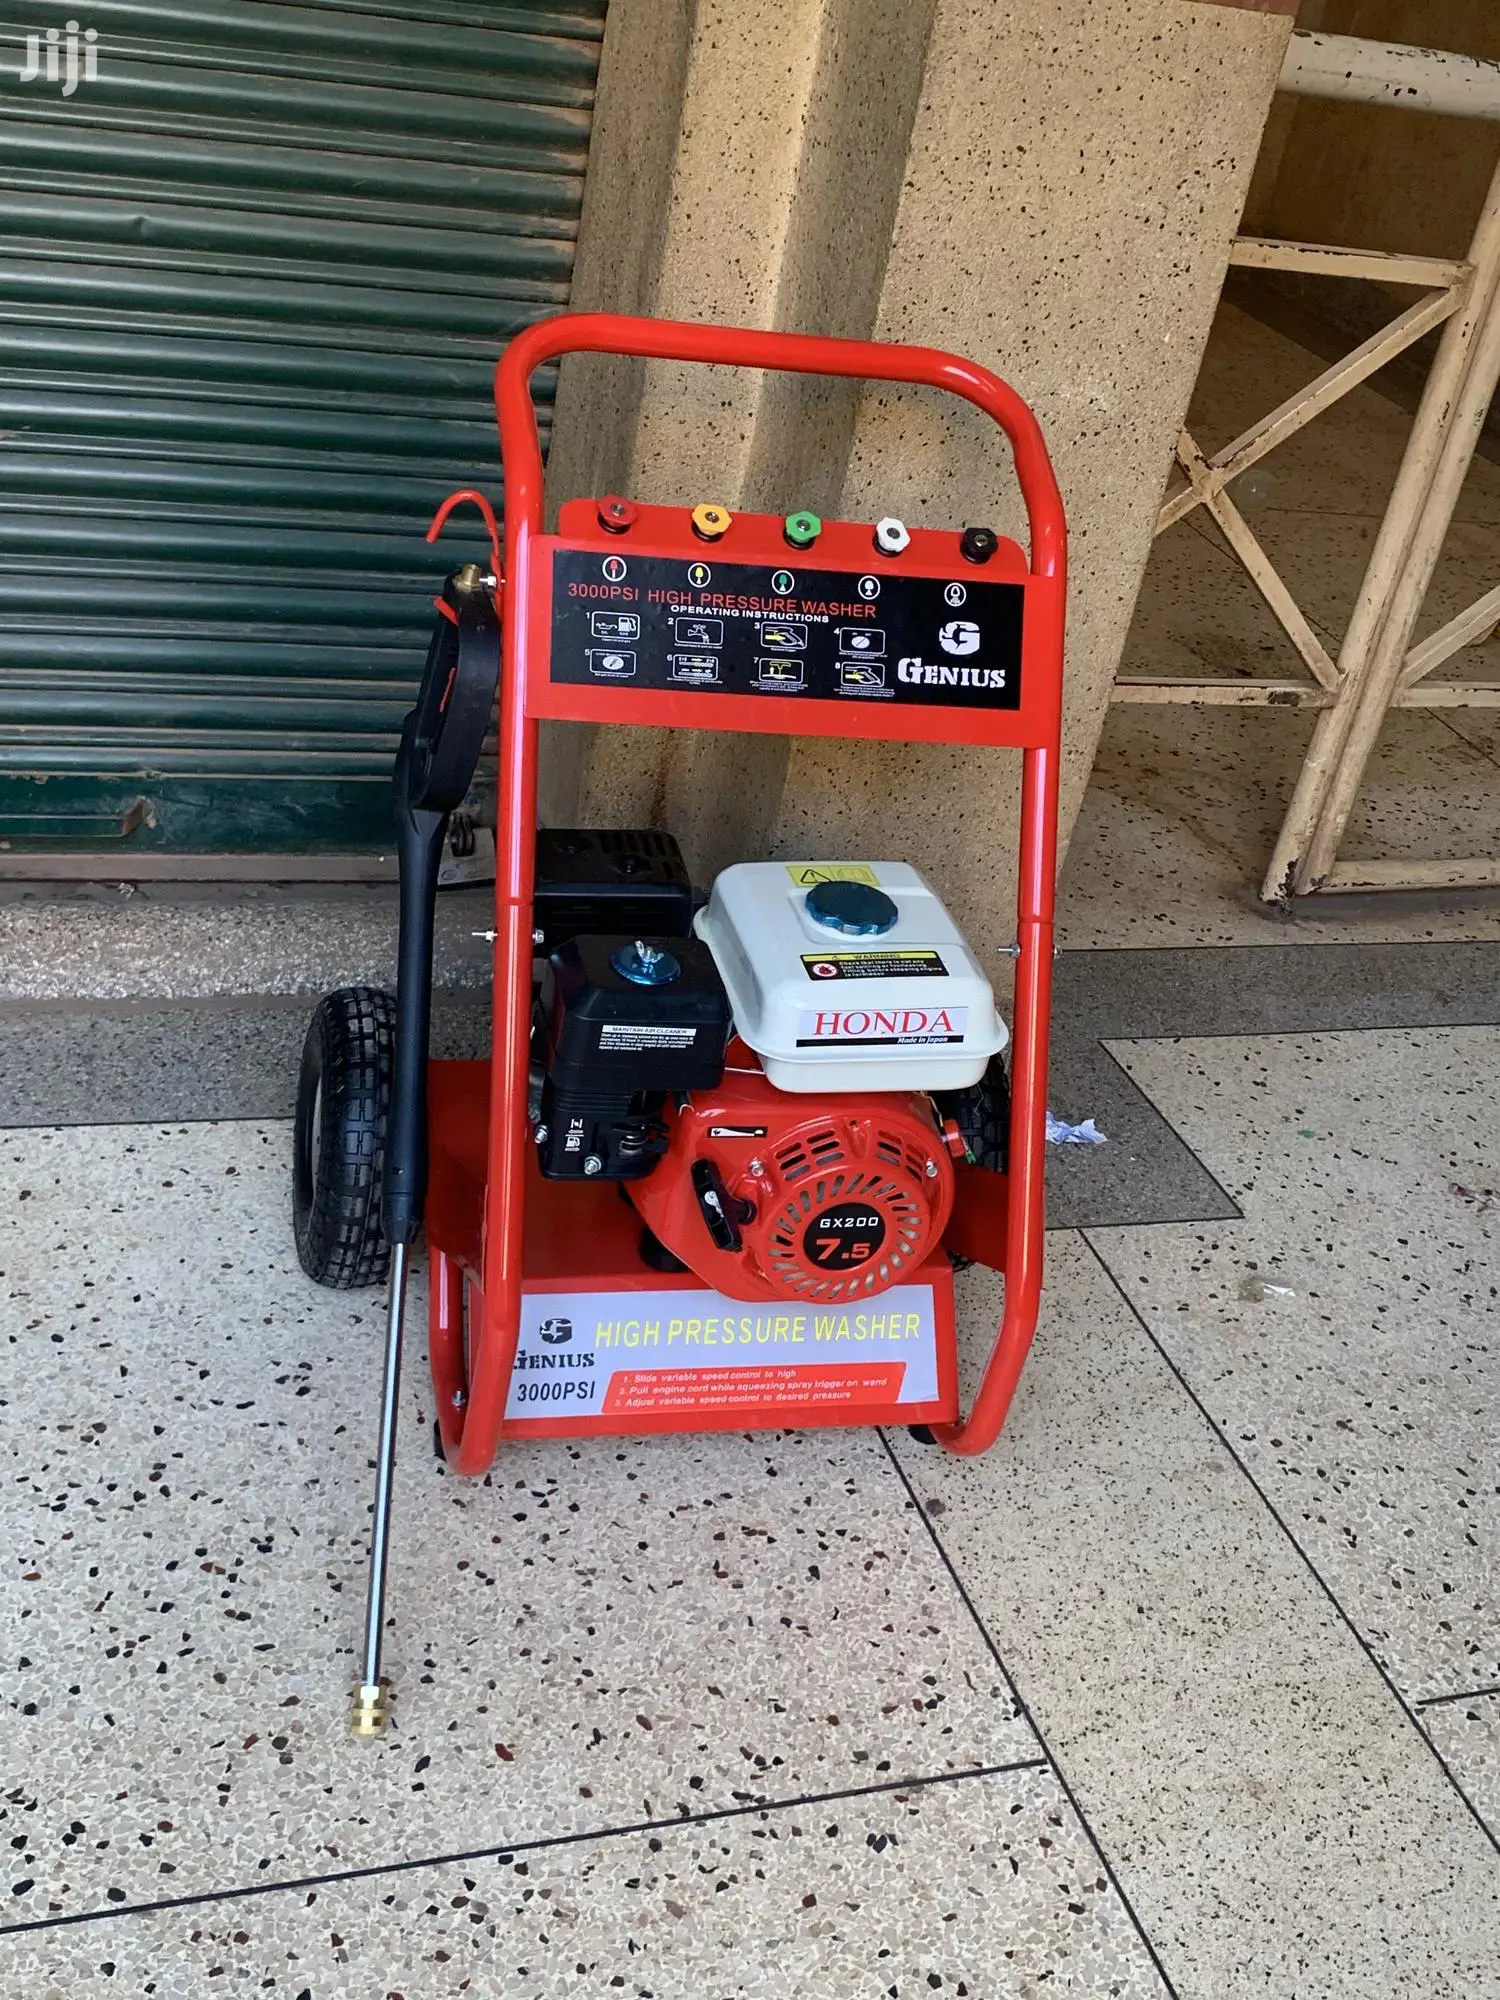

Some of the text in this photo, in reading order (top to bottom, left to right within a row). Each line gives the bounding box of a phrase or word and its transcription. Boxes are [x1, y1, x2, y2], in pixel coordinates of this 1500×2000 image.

[568, 583, 877, 618] 3000PSI HIGH PRESSURE WASHER
[585, 611, 591, 619] 1
[667, 617, 674, 625] 2
[670, 604, 829, 623] OPERATING INSTRUCTIONS
[833, 627, 840, 635] 4
[666, 654, 673, 662] 6
[753, 656, 759, 664] 7
[834, 662, 841, 670] 8
[897, 657, 1006, 689] GENIUS
[812, 1009, 954, 1036] HONDA
[897, 1036, 918, 1044] Made
[819, 1216, 879, 1229] GX200
[815, 1238, 872, 1261] 7.5
[594, 1313, 921, 1349] HIGH PRESSURE WASHER
[634, 1374, 657, 1383] Slide
[661, 1372, 697, 1382] variable
[701, 1372, 729, 1382] speed
[730, 1370, 761, 1380] control
[764, 1370, 774, 1378] to
[777, 1369, 797, 1380] high
[517, 1380, 596, 1402] 3000PSI
[629, 1386, 649, 1395] Pull
[653, 1386, 686, 1396] engine
[687, 1384, 709, 1393] cord
[710, 1383, 735, 1392] while
[737, 1382, 785, 1392] squeezing
[787, 1381, 813, 1390] spray
[814, 1379, 845, 1390] trigger
[846, 1379, 858, 1387] on
[862, 1378, 888, 1387] wand
[625, 1397, 656, 1408] Adjust
[659, 1396, 695, 1405] variable
[699, 1395, 728, 1405] speed
[728, 1393, 760, 1403] control
[763, 1393, 772, 1402] to
[776, 1392, 809, 1401] desired
[812, 1391, 852, 1401] pressure
